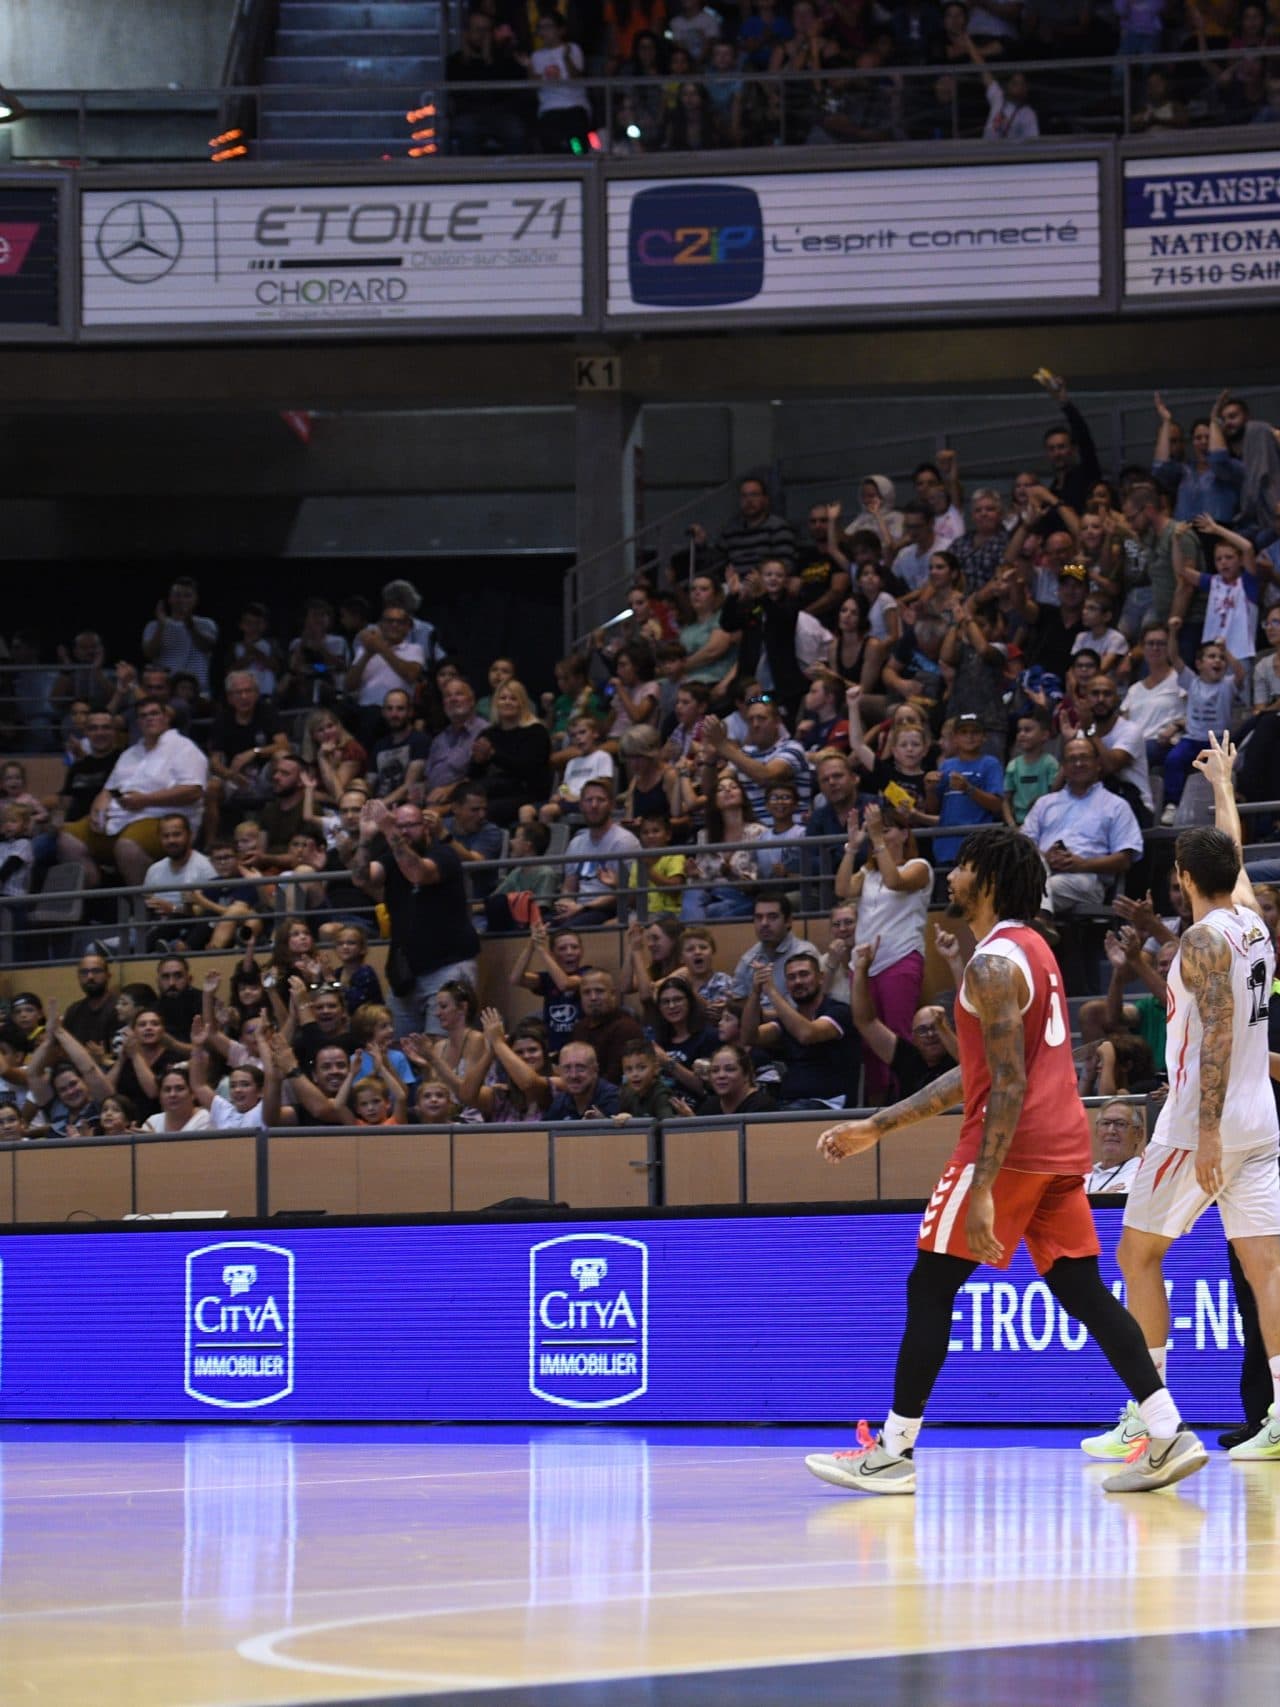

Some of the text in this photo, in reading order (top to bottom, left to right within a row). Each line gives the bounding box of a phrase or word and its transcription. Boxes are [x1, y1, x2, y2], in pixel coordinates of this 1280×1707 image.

[253, 198, 568, 246] ETOILE 71
[772, 220, 1080, 253] L'esprit connecté
[1150, 264, 1223, 286] 71510
[255, 277, 408, 305] CHOPARD
[194, 1355, 284, 1377] IMMOBILIER
[539, 1352, 637, 1377] IMMOBILIER
